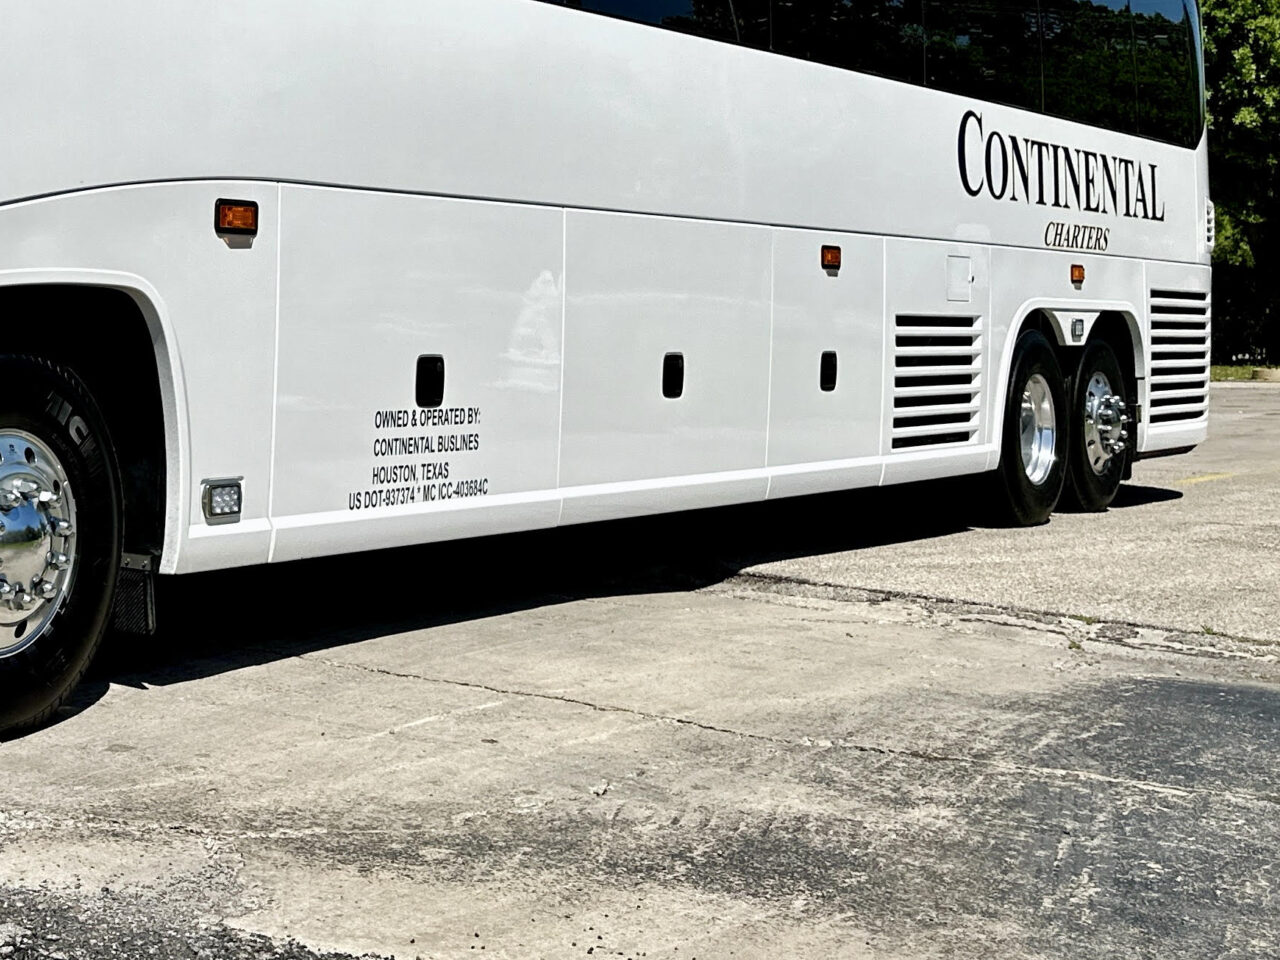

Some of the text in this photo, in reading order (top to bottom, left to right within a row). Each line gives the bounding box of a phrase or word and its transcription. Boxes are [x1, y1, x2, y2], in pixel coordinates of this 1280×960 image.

[957, 109, 1165, 222] CONTINENTAL
[1044, 221, 1110, 251] CHARTERS
[374, 407, 481, 429] OWNED & OPERATED BY:
[373, 433, 479, 457] CONTINENTAL BUSLINES
[372, 461, 449, 485] HOUSTON, TEXAS
[349, 491, 362, 511] US
[364, 486, 415, 509] DOT-937374
[423, 483, 436, 502] MC
